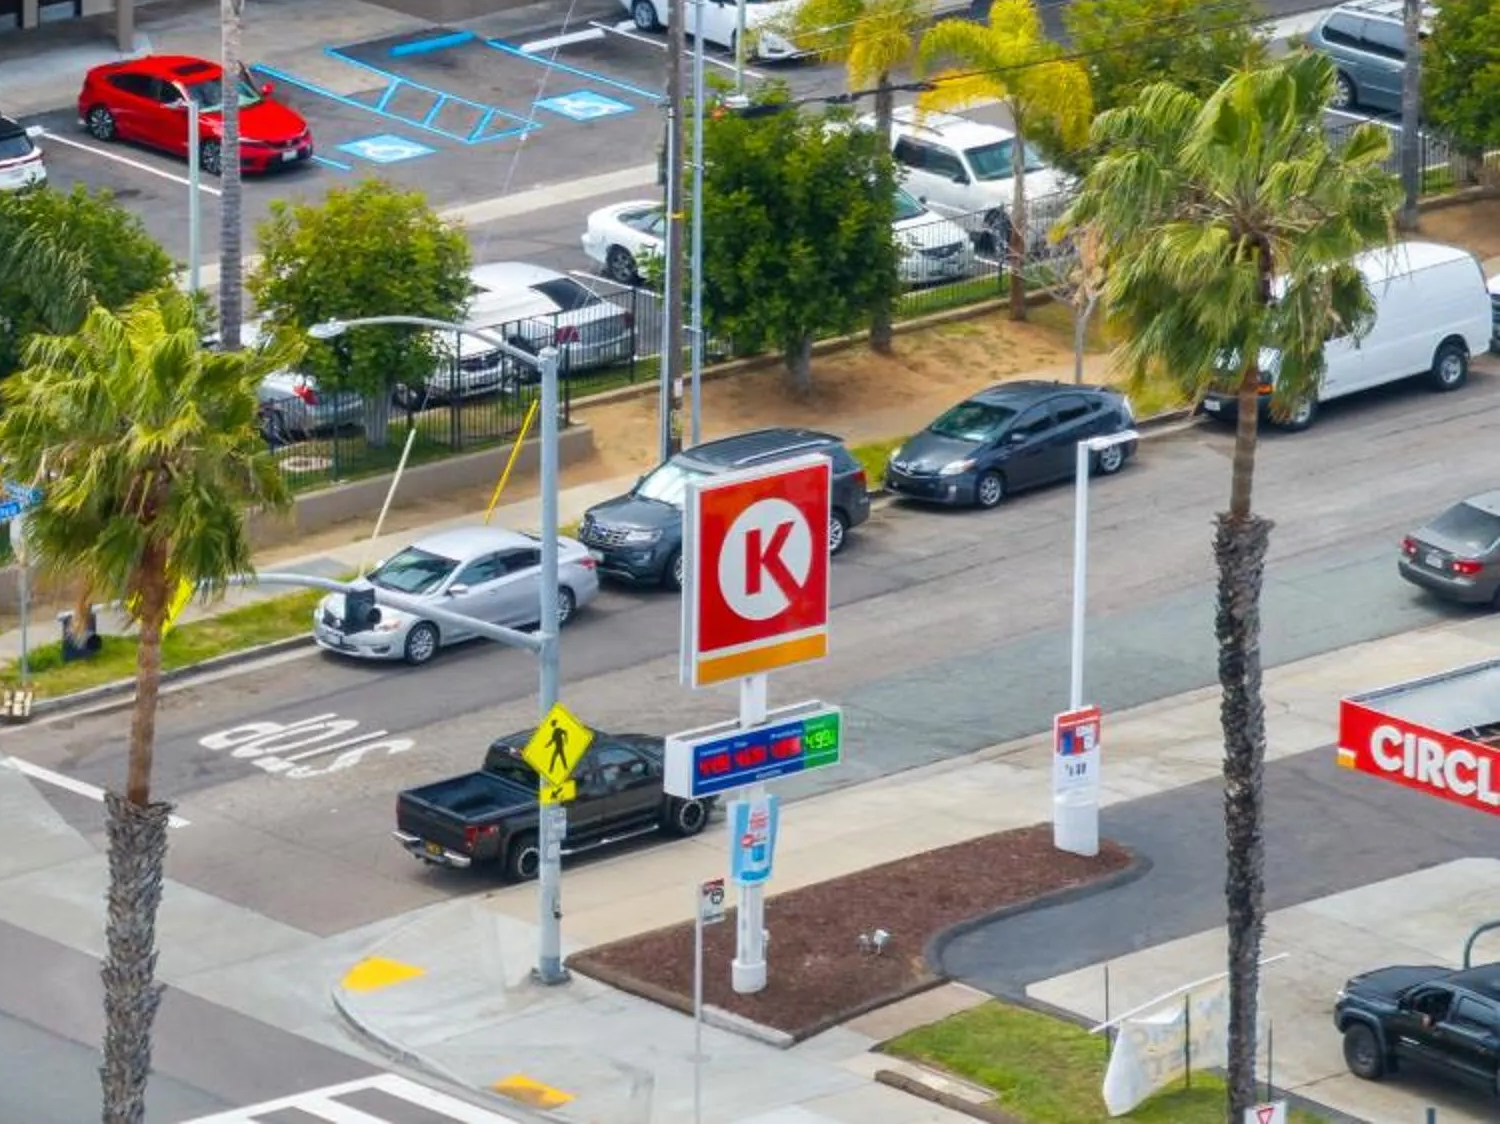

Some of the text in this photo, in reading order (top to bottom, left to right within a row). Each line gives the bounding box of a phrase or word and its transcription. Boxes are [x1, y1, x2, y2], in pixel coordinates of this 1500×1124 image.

[742, 517, 804, 607] K
[198, 712, 416, 779] STOP
[1370, 724, 1500, 807] CIRCL
